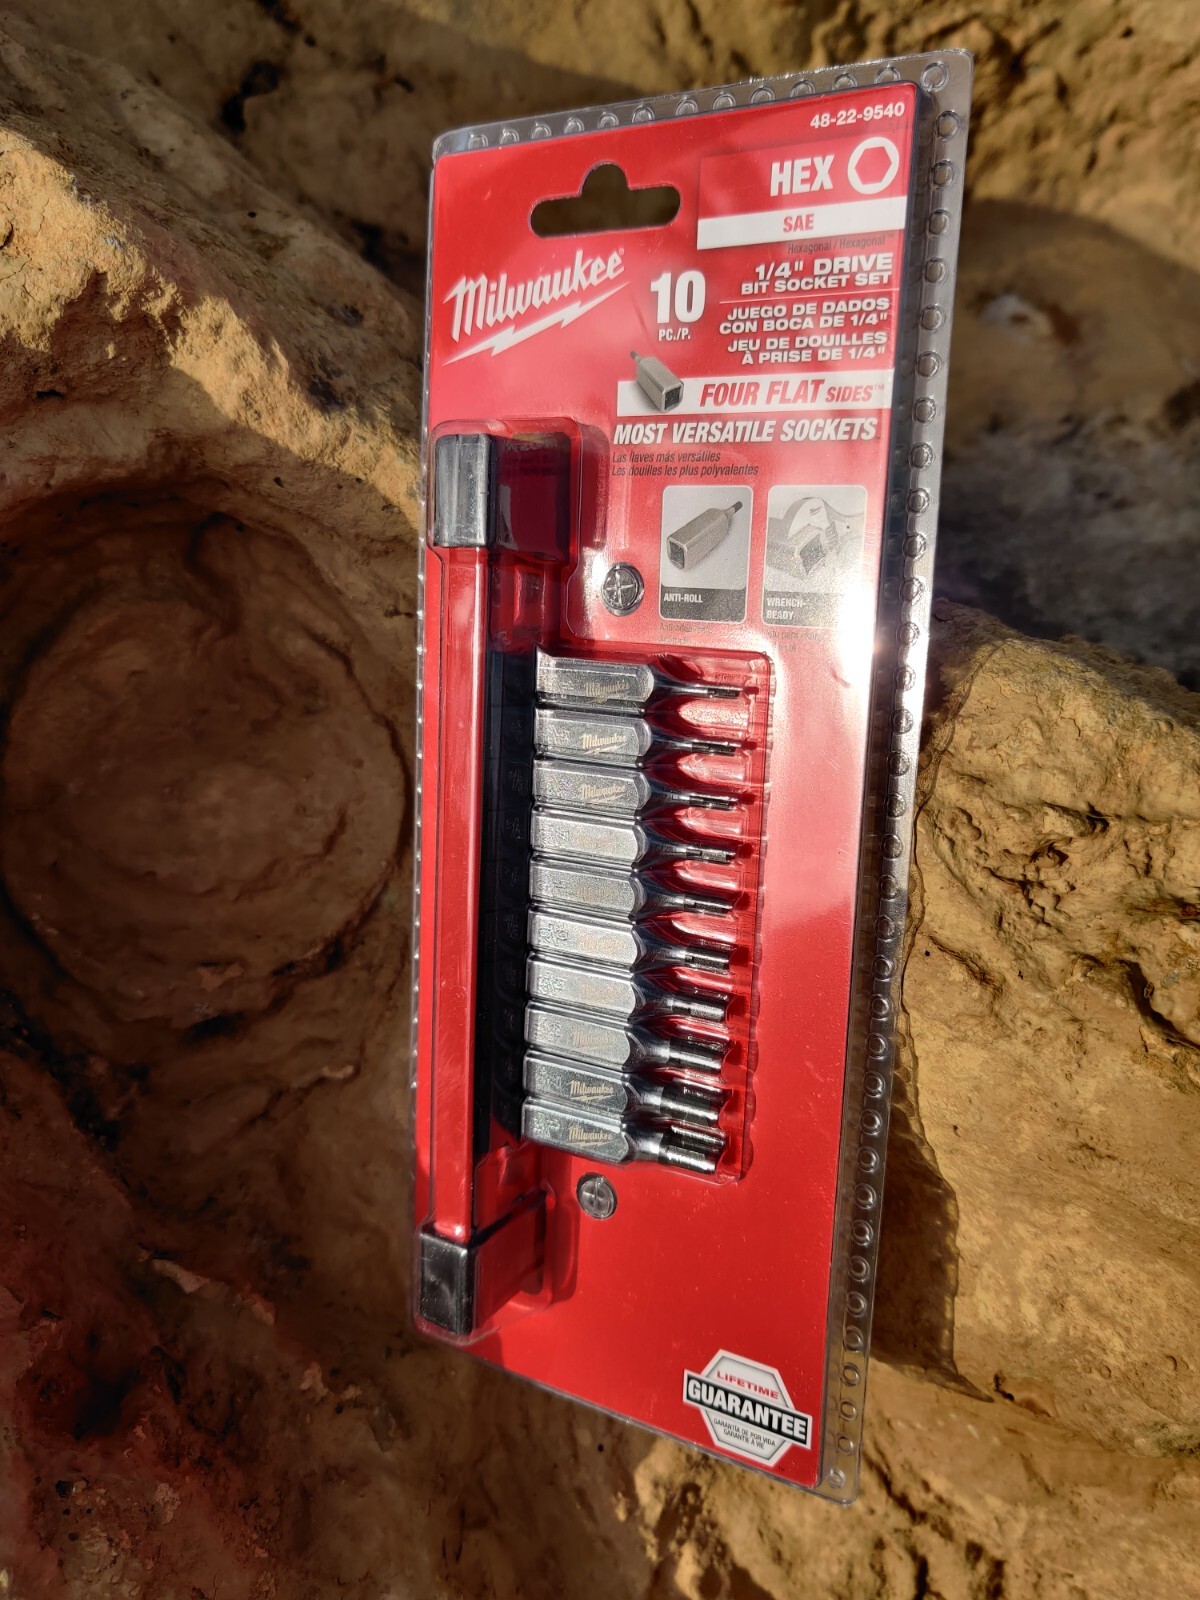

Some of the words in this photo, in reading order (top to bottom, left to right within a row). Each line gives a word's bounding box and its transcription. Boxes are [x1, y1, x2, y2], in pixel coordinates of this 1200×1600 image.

[810, 102, 905, 129] 48-22-9540
[770, 155, 835, 197] HEX
[783, 213, 814, 233] SAE
[787, 241, 831, 255] Hexagonal
[839, 235, 886, 249] Hexagonal
[755, 260, 803, 280] 1/4"
[813, 252, 894, 275] DRIVE
[741, 281, 769, 295] BIT
[774, 275, 850, 293] SOCKET
[855, 271, 892, 286] SET
[651, 270, 706, 324] 10
[727, 305, 787, 320] JUEGO
[792, 303, 817, 316] DE
[822, 297, 890, 314] DADOS
[719, 320, 758, 335] CON
[763, 317, 814, 331] BOCA
[819, 315, 845, 328] DE
[850, 312, 888, 326] 1/4"
[727, 338, 760, 352] JEU
[766, 337, 790, 350] DE
[795, 331, 887, 349] DOUILLES
[758, 350, 812, 364] PRISE
[818, 348, 842, 361] DE
[700, 381, 760, 407] FOUR
[766, 379, 825, 405] FLAT
[613, 423, 668, 445] MOST
[672, 420, 776, 444] VERSATILE
[780, 418, 878, 442] SOCKETS
[612, 452, 627, 463] Las
[611, 465, 626, 476] Les
[628, 465, 662, 477] douilles
[664, 464, 677, 476] les
[678, 464, 699, 478] plus
[700, 464, 759, 478] polyvalentes
[663, 593, 703, 603] ANTI-ROLL
[581, 732, 627, 749] Milwaukee
[579, 783, 626, 800] Milwaukee
[568, 1080, 614, 1096] Milwaukee
[568, 1124, 613, 1141] Milwaukee
[716, 1369, 779, 1400] LIFETIME
[687, 1378, 807, 1440] GUARANTEE
[741, 1427, 749, 1436] DE
